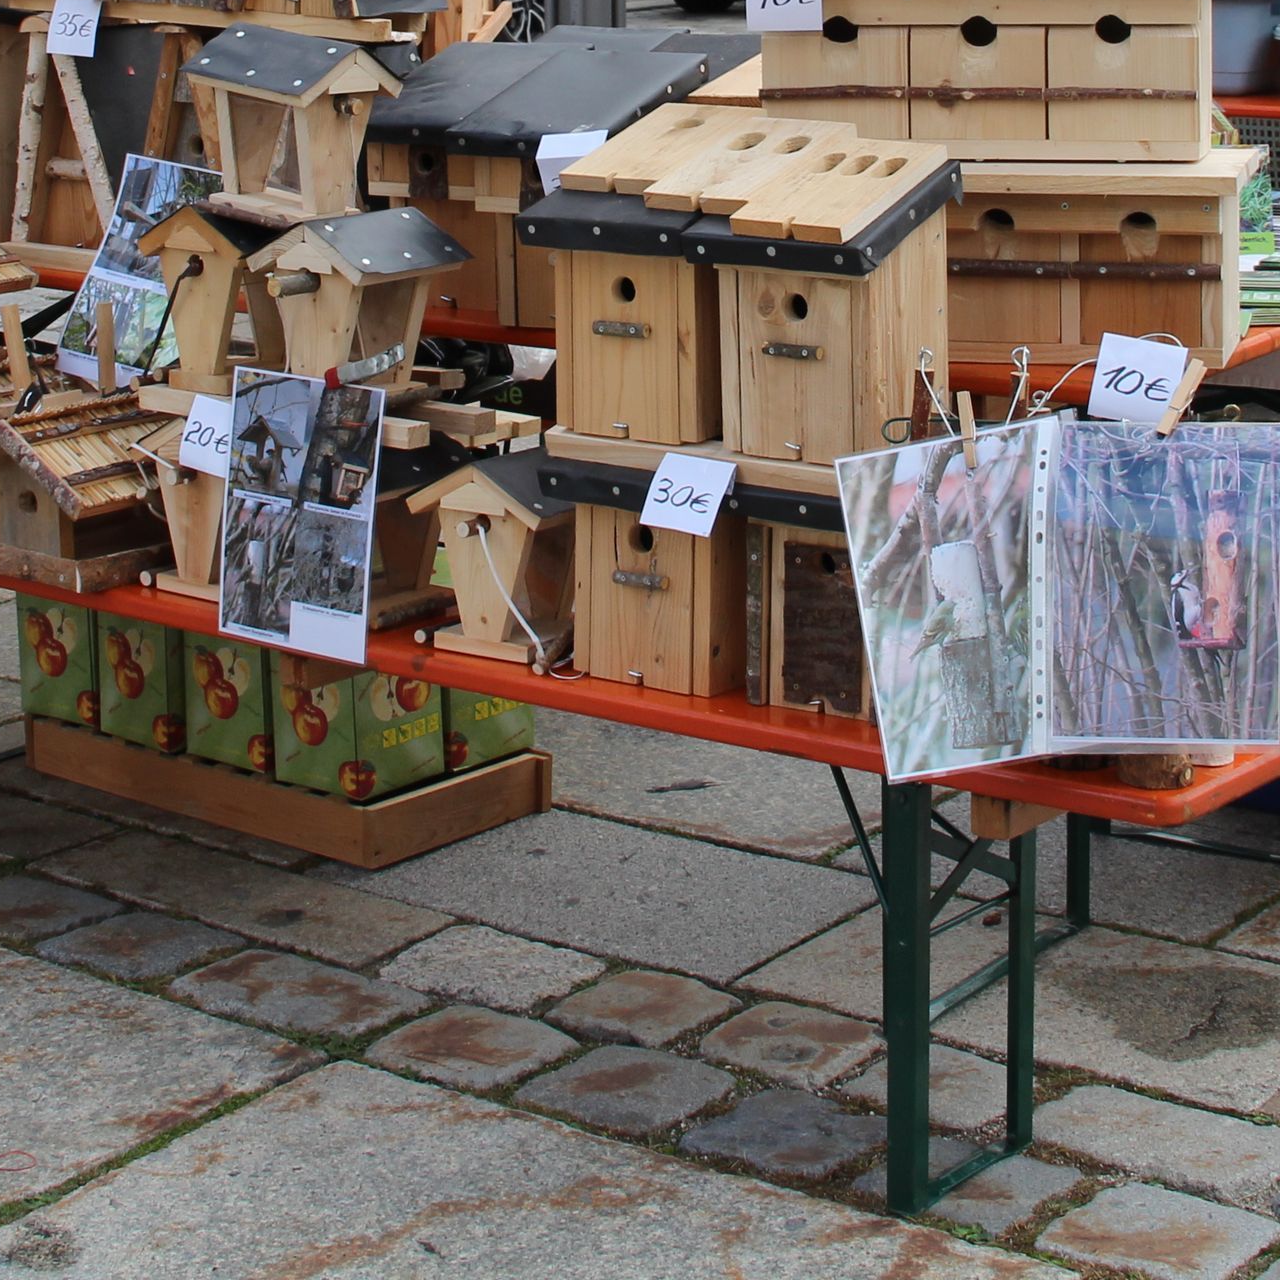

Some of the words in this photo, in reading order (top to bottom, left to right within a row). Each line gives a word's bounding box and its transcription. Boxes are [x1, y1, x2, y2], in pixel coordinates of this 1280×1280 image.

[55, 12, 94, 38] 35€
[1100, 364, 1172, 403] 10€
[183, 419, 229, 455] 20€
[653, 476, 710, 515] 30€
